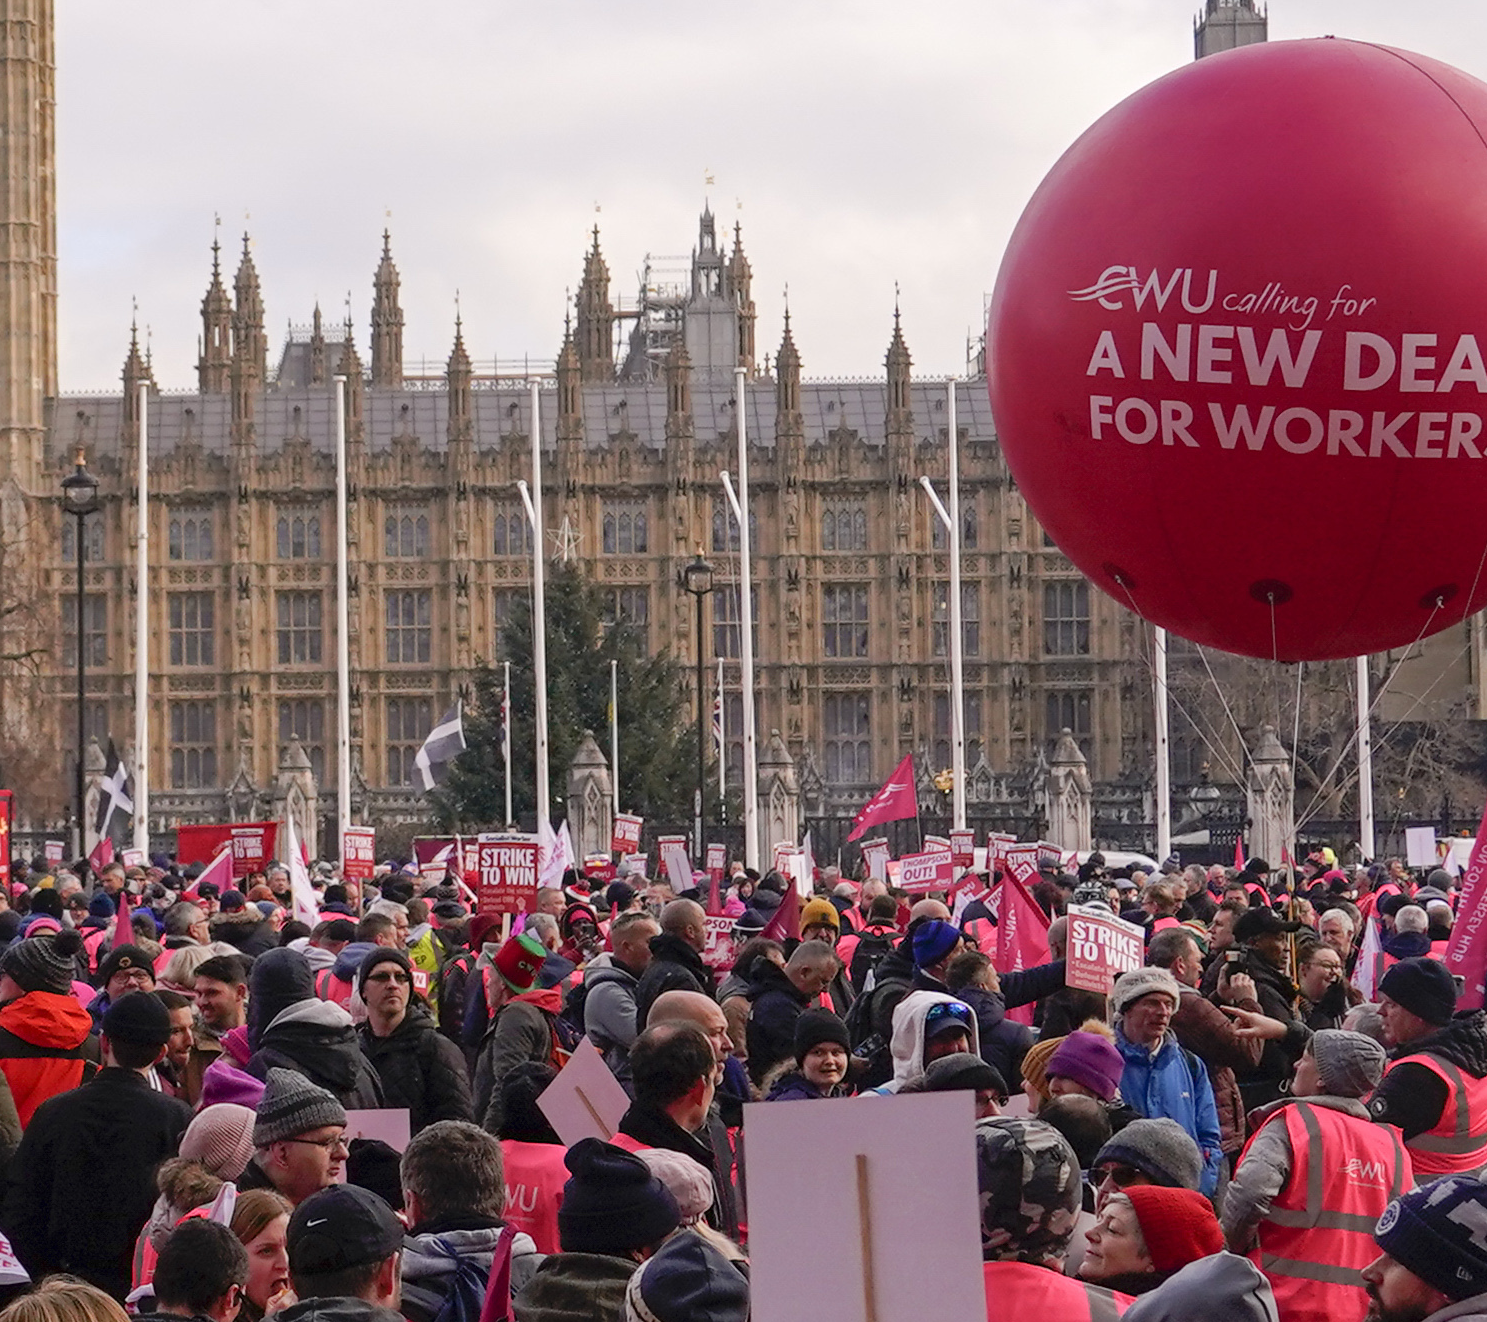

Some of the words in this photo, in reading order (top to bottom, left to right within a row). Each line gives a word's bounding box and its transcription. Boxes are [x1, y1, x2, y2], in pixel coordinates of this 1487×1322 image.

[1068, 265, 1217, 313] CWU
[1222, 282, 1319, 331] calling
[1326, 285, 1377, 321] for
[1087, 330, 1125, 378] A
[1141, 322, 1322, 389] NEW
[1090, 396, 1200, 447] FOR
[345, 836, 373, 848] STRIKE
[481, 848, 535, 867] STRIKE
[903, 854, 949, 867] THOMPSON
[481, 867, 500, 885] TO
[505, 867, 535, 885] WIN
[904, 867, 933, 880] OUT!
[1073, 920, 1140, 959] STRIKE
[1071, 938, 1098, 961] TO
[1105, 945, 1140, 973] WIN
